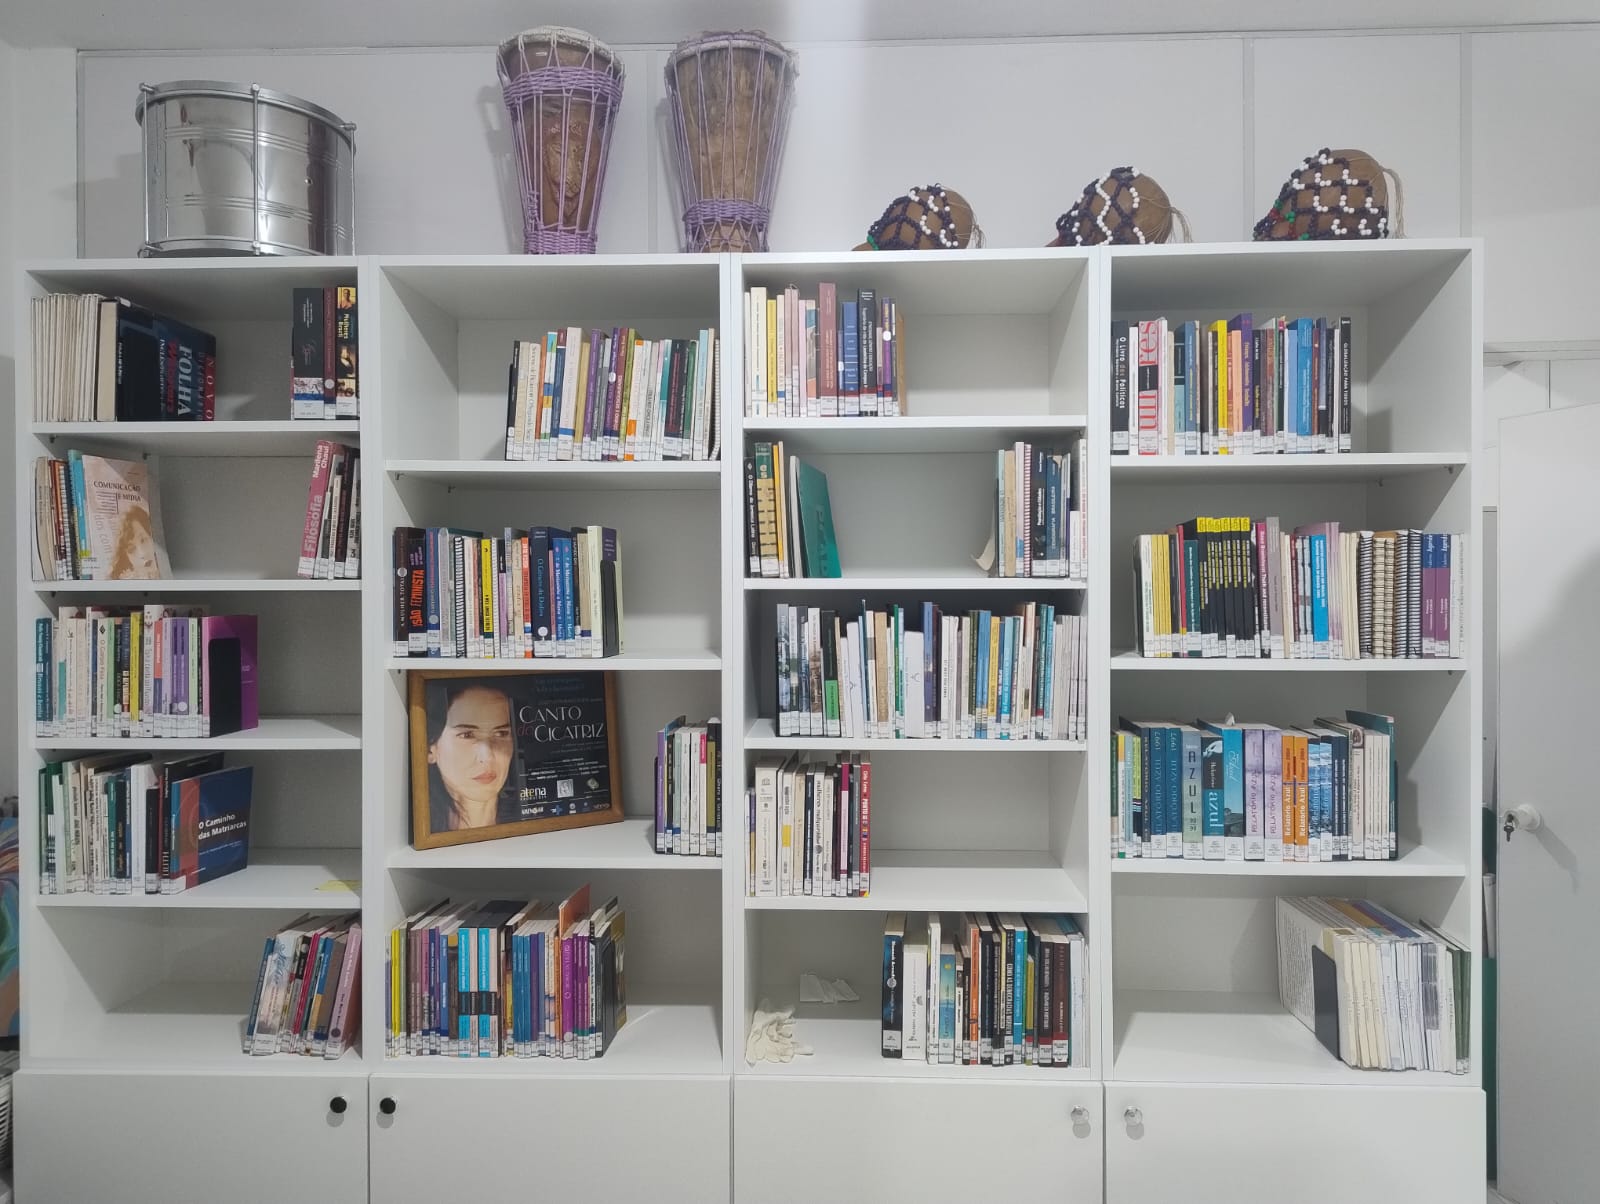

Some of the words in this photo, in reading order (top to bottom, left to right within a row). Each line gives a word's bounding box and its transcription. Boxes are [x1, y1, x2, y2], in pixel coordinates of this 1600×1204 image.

[177, 344, 193, 417] FOLHA
[206, 357, 215, 420] NOVO
[311, 444, 323, 479] Marilena
[93, 480, 141, 493] COMUNICAÇÃO
[303, 494, 322, 553] Filosofia
[519, 706, 583, 725] CANTO
[535, 723, 606, 745] CICATRIZ
[1170, 731, 1178, 752] 1997
[1188, 750, 1197, 814] AZUL
[1298, 786, 1306, 804] Azul
[198, 821, 204, 829] O
[205, 812, 236, 827] Caminho
[1208, 791, 1225, 828] azul
[198, 831, 210, 840] das
[211, 820, 248, 837] Matriarcas
